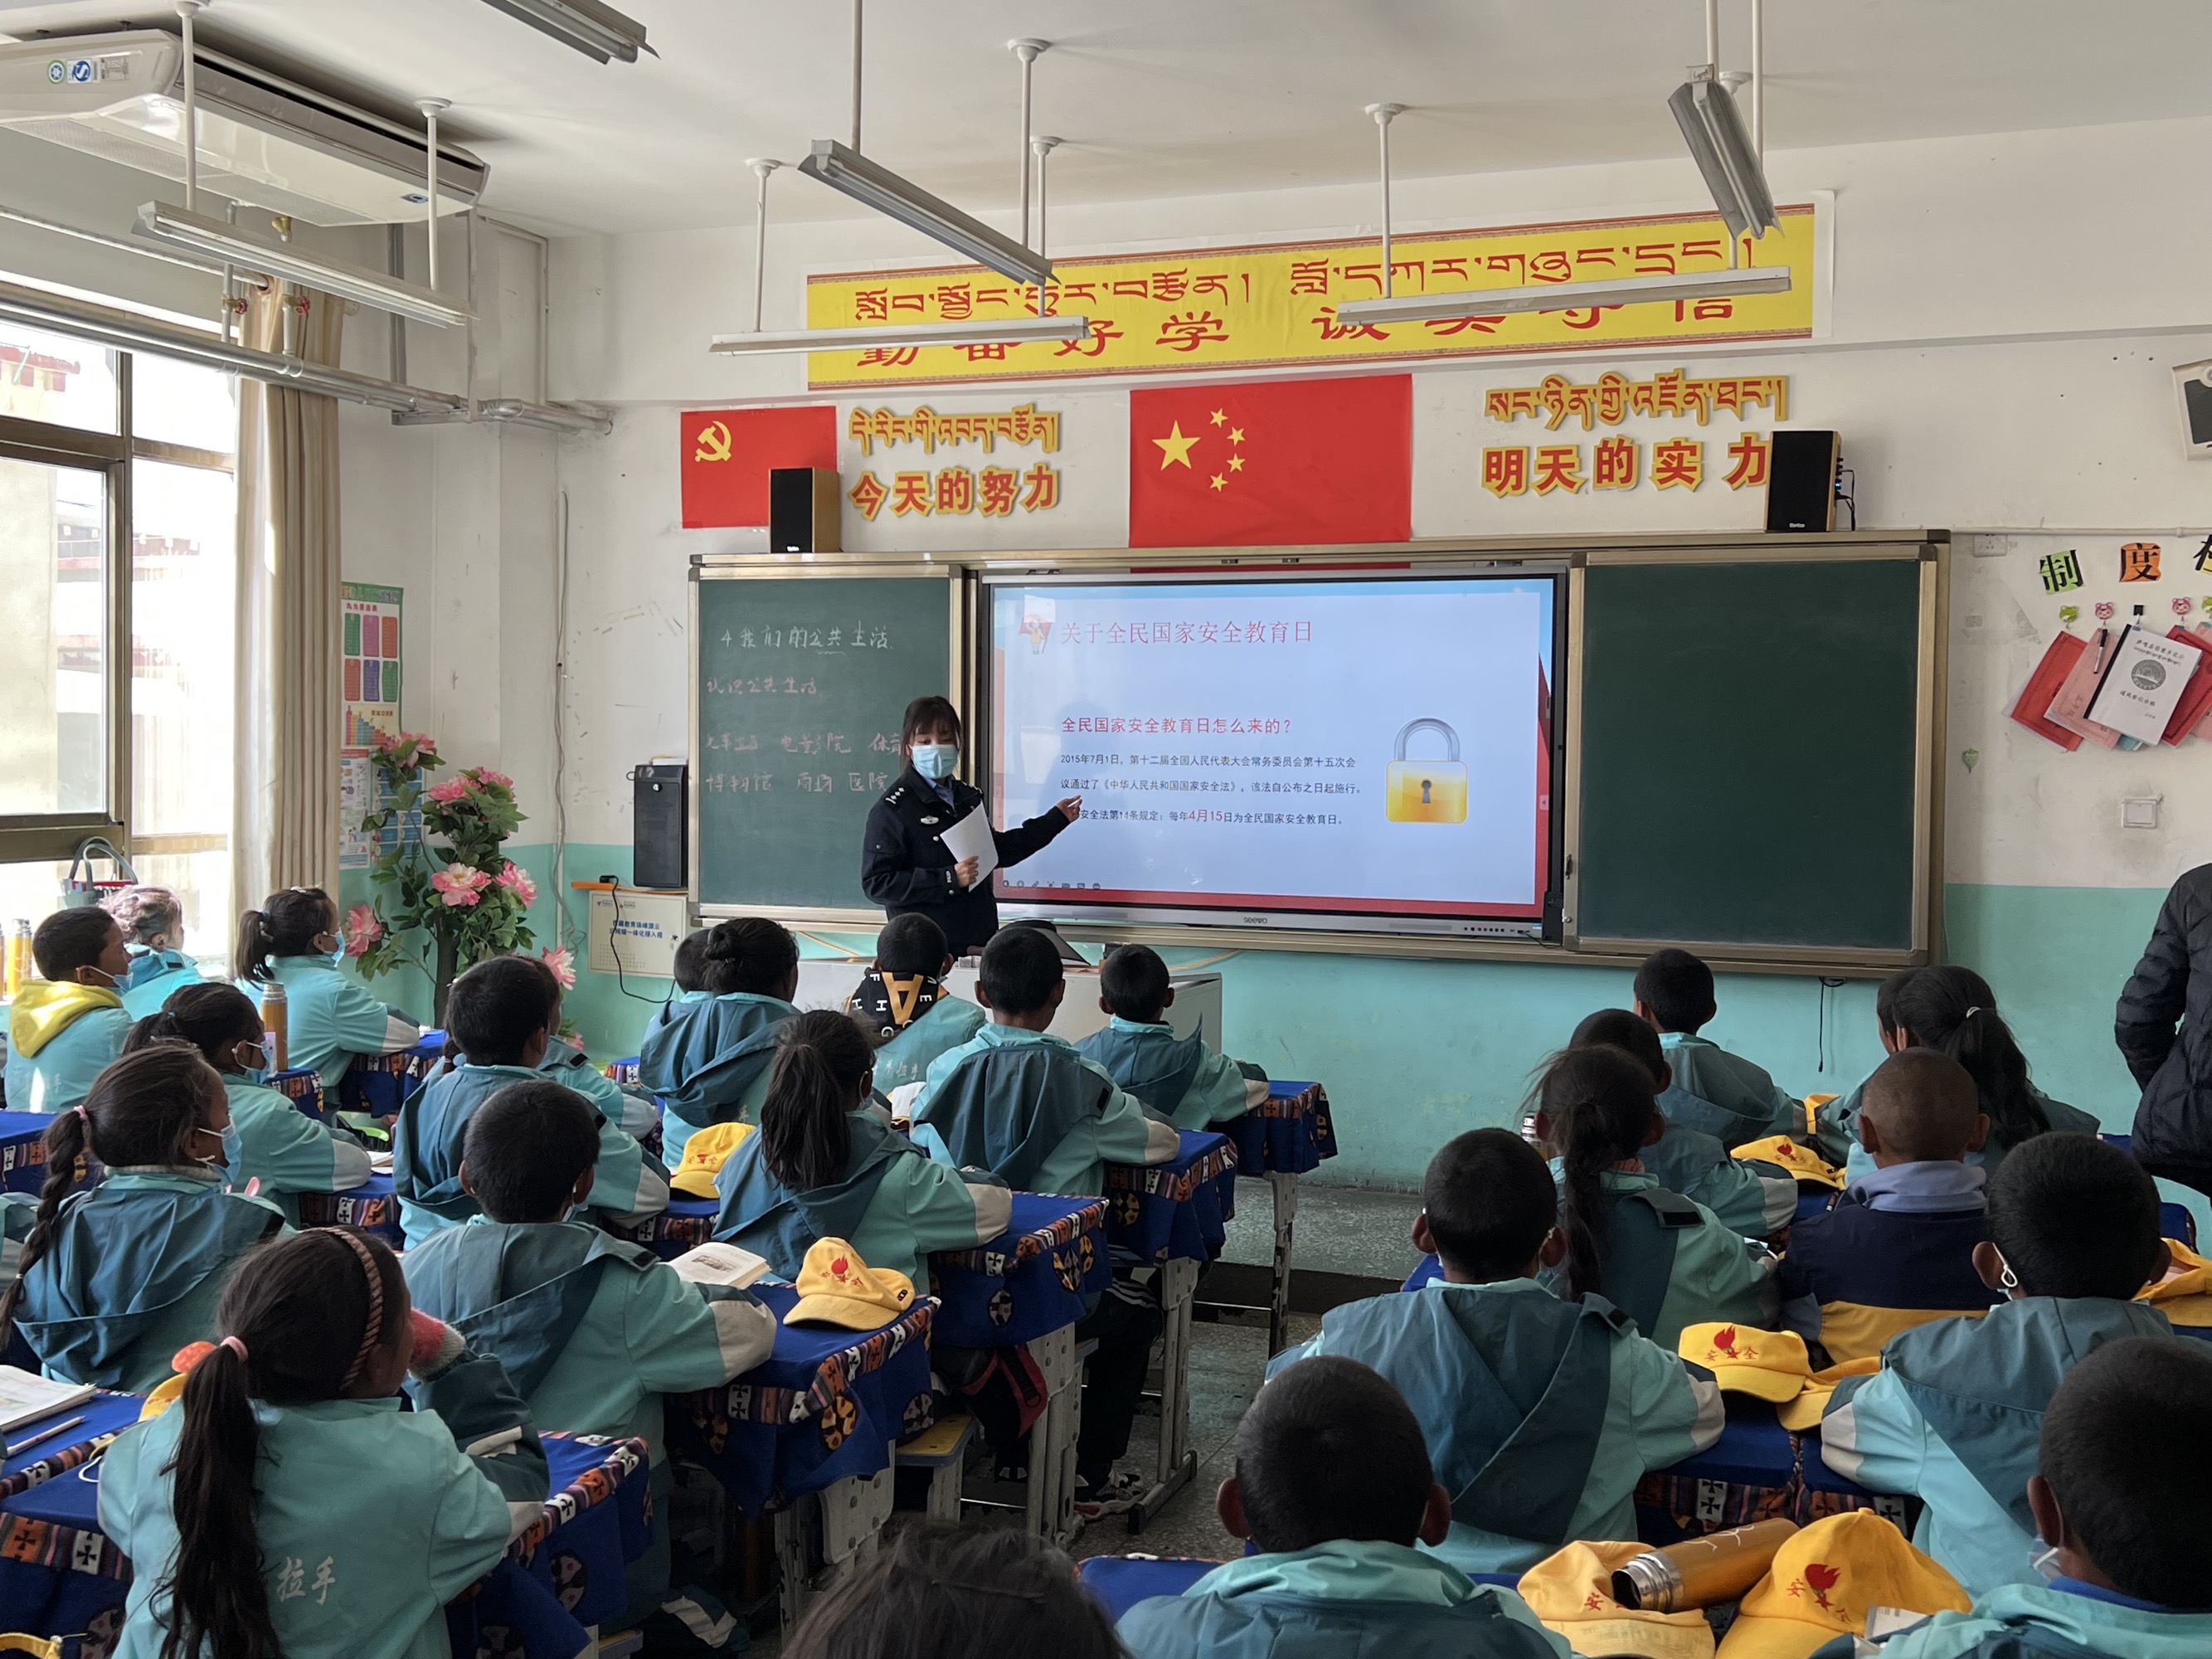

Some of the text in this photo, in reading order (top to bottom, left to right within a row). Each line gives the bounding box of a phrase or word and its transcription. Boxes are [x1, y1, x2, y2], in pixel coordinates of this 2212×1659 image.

[1485, 435, 1767, 492] 明天的实力
[851, 465, 1057, 518] 今天的努力
[1060, 620, 1312, 645] 关于全民国家安全教育日
[1061, 716, 1291, 735] 全民国家安全教育日怎么来的？
[848, 771, 890, 792] 医院
[1078, 809, 1343, 825] 安全法第14条规定：每年4月15日为全民国家安全教育日。
[1243, 916, 1268, 925] seewo
[1705, 1345, 1759, 1362] 安 全
[276, 1555, 337, 1607] 拉手
[1787, 1578, 1806, 1598] 安
[1584, 1592, 1605, 1611] 安
